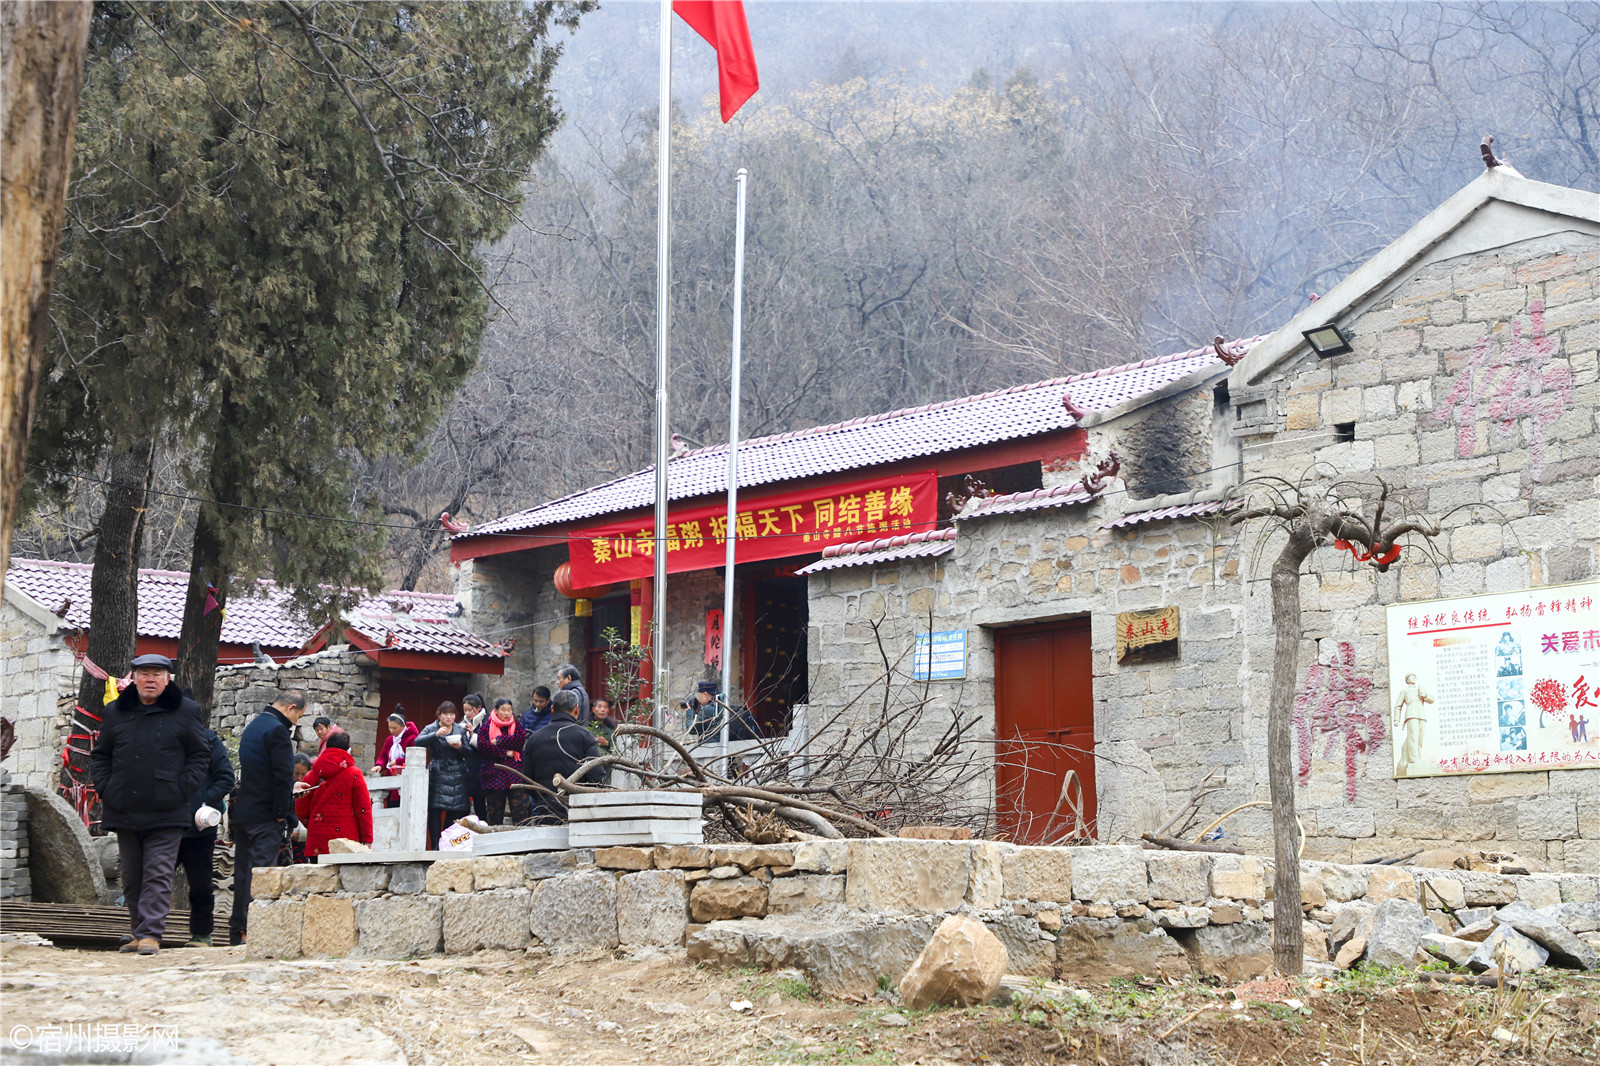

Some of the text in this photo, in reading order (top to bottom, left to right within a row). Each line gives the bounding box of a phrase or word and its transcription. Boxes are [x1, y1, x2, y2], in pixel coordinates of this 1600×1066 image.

[709, 504, 804, 545] 祈福天下
[813, 486, 914, 529] 同结善缘
[1407, 596, 1593, 630] 继承优良传统 弘扬雷锋精神
[1439, 750, 1600, 769] 把有限的生命投入到无限的为人
